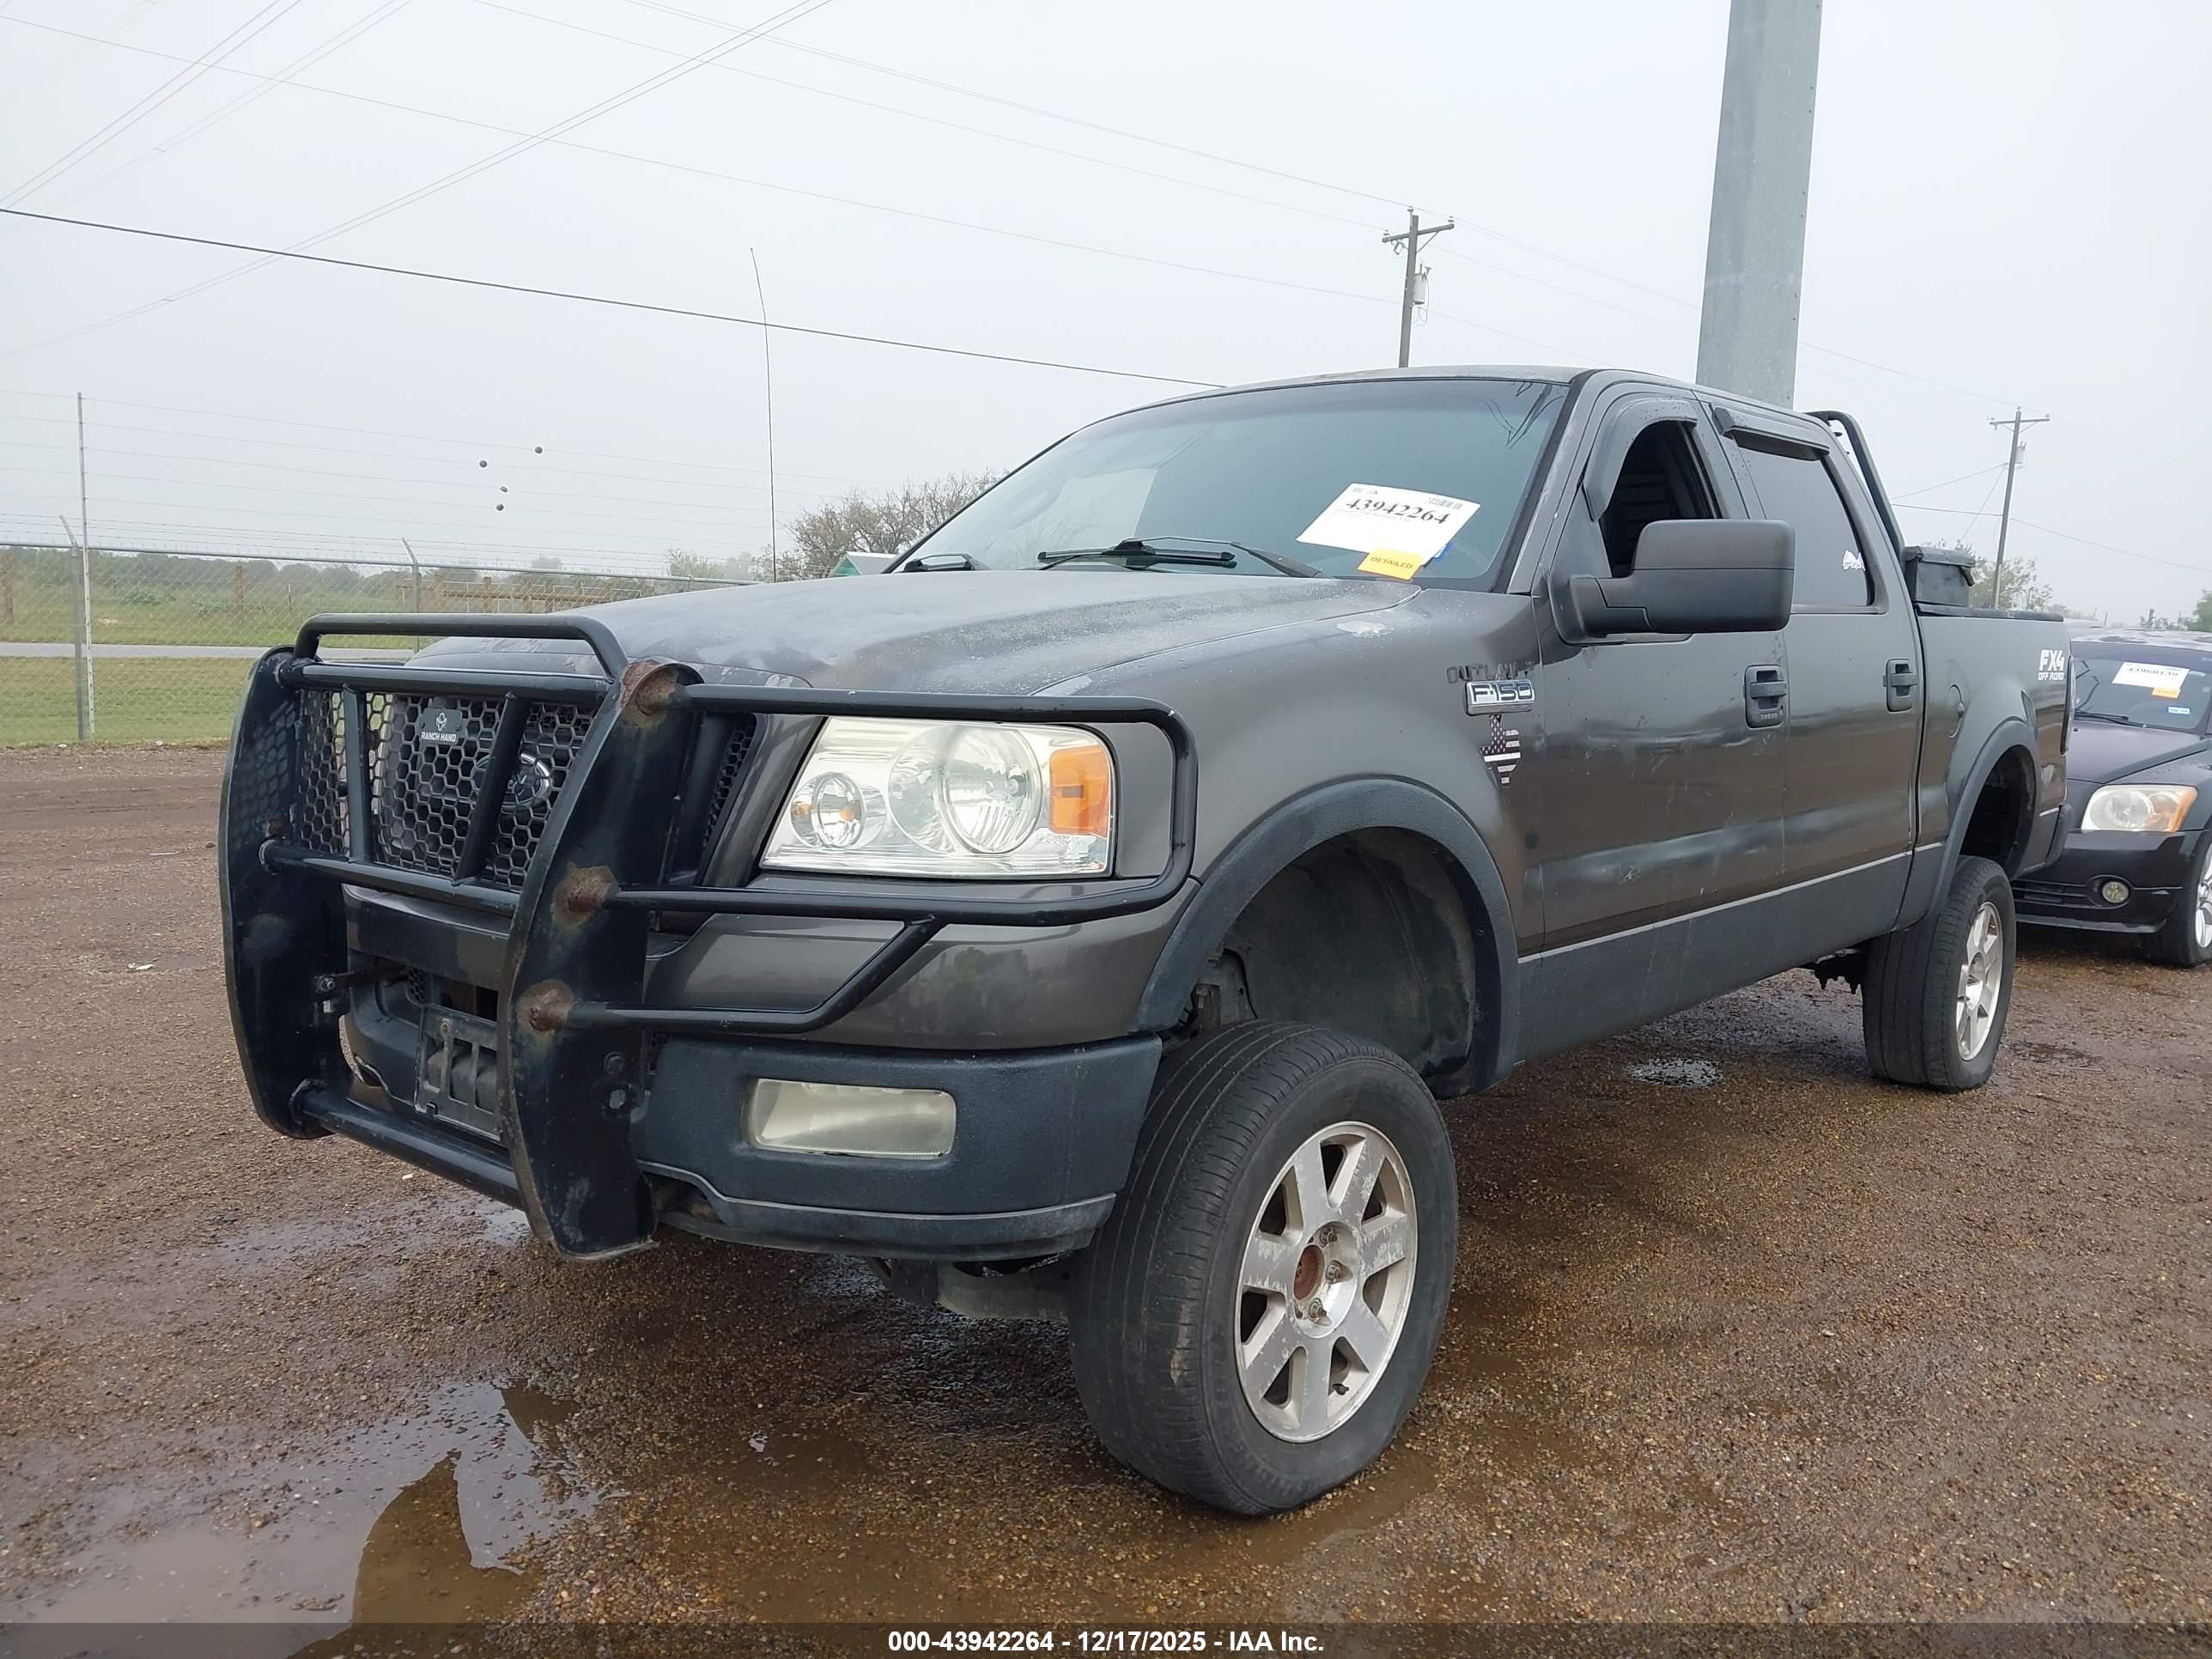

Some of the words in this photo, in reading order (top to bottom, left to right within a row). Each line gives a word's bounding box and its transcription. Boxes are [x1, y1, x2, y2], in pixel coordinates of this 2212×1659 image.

[1346, 498, 1450, 524] 43942264
[1370, 556, 1413, 569] DETAILED
[2039, 649, 2065, 672] FX4
[421, 731, 440, 741] RANCH
[441, 732, 457, 742] HAND
